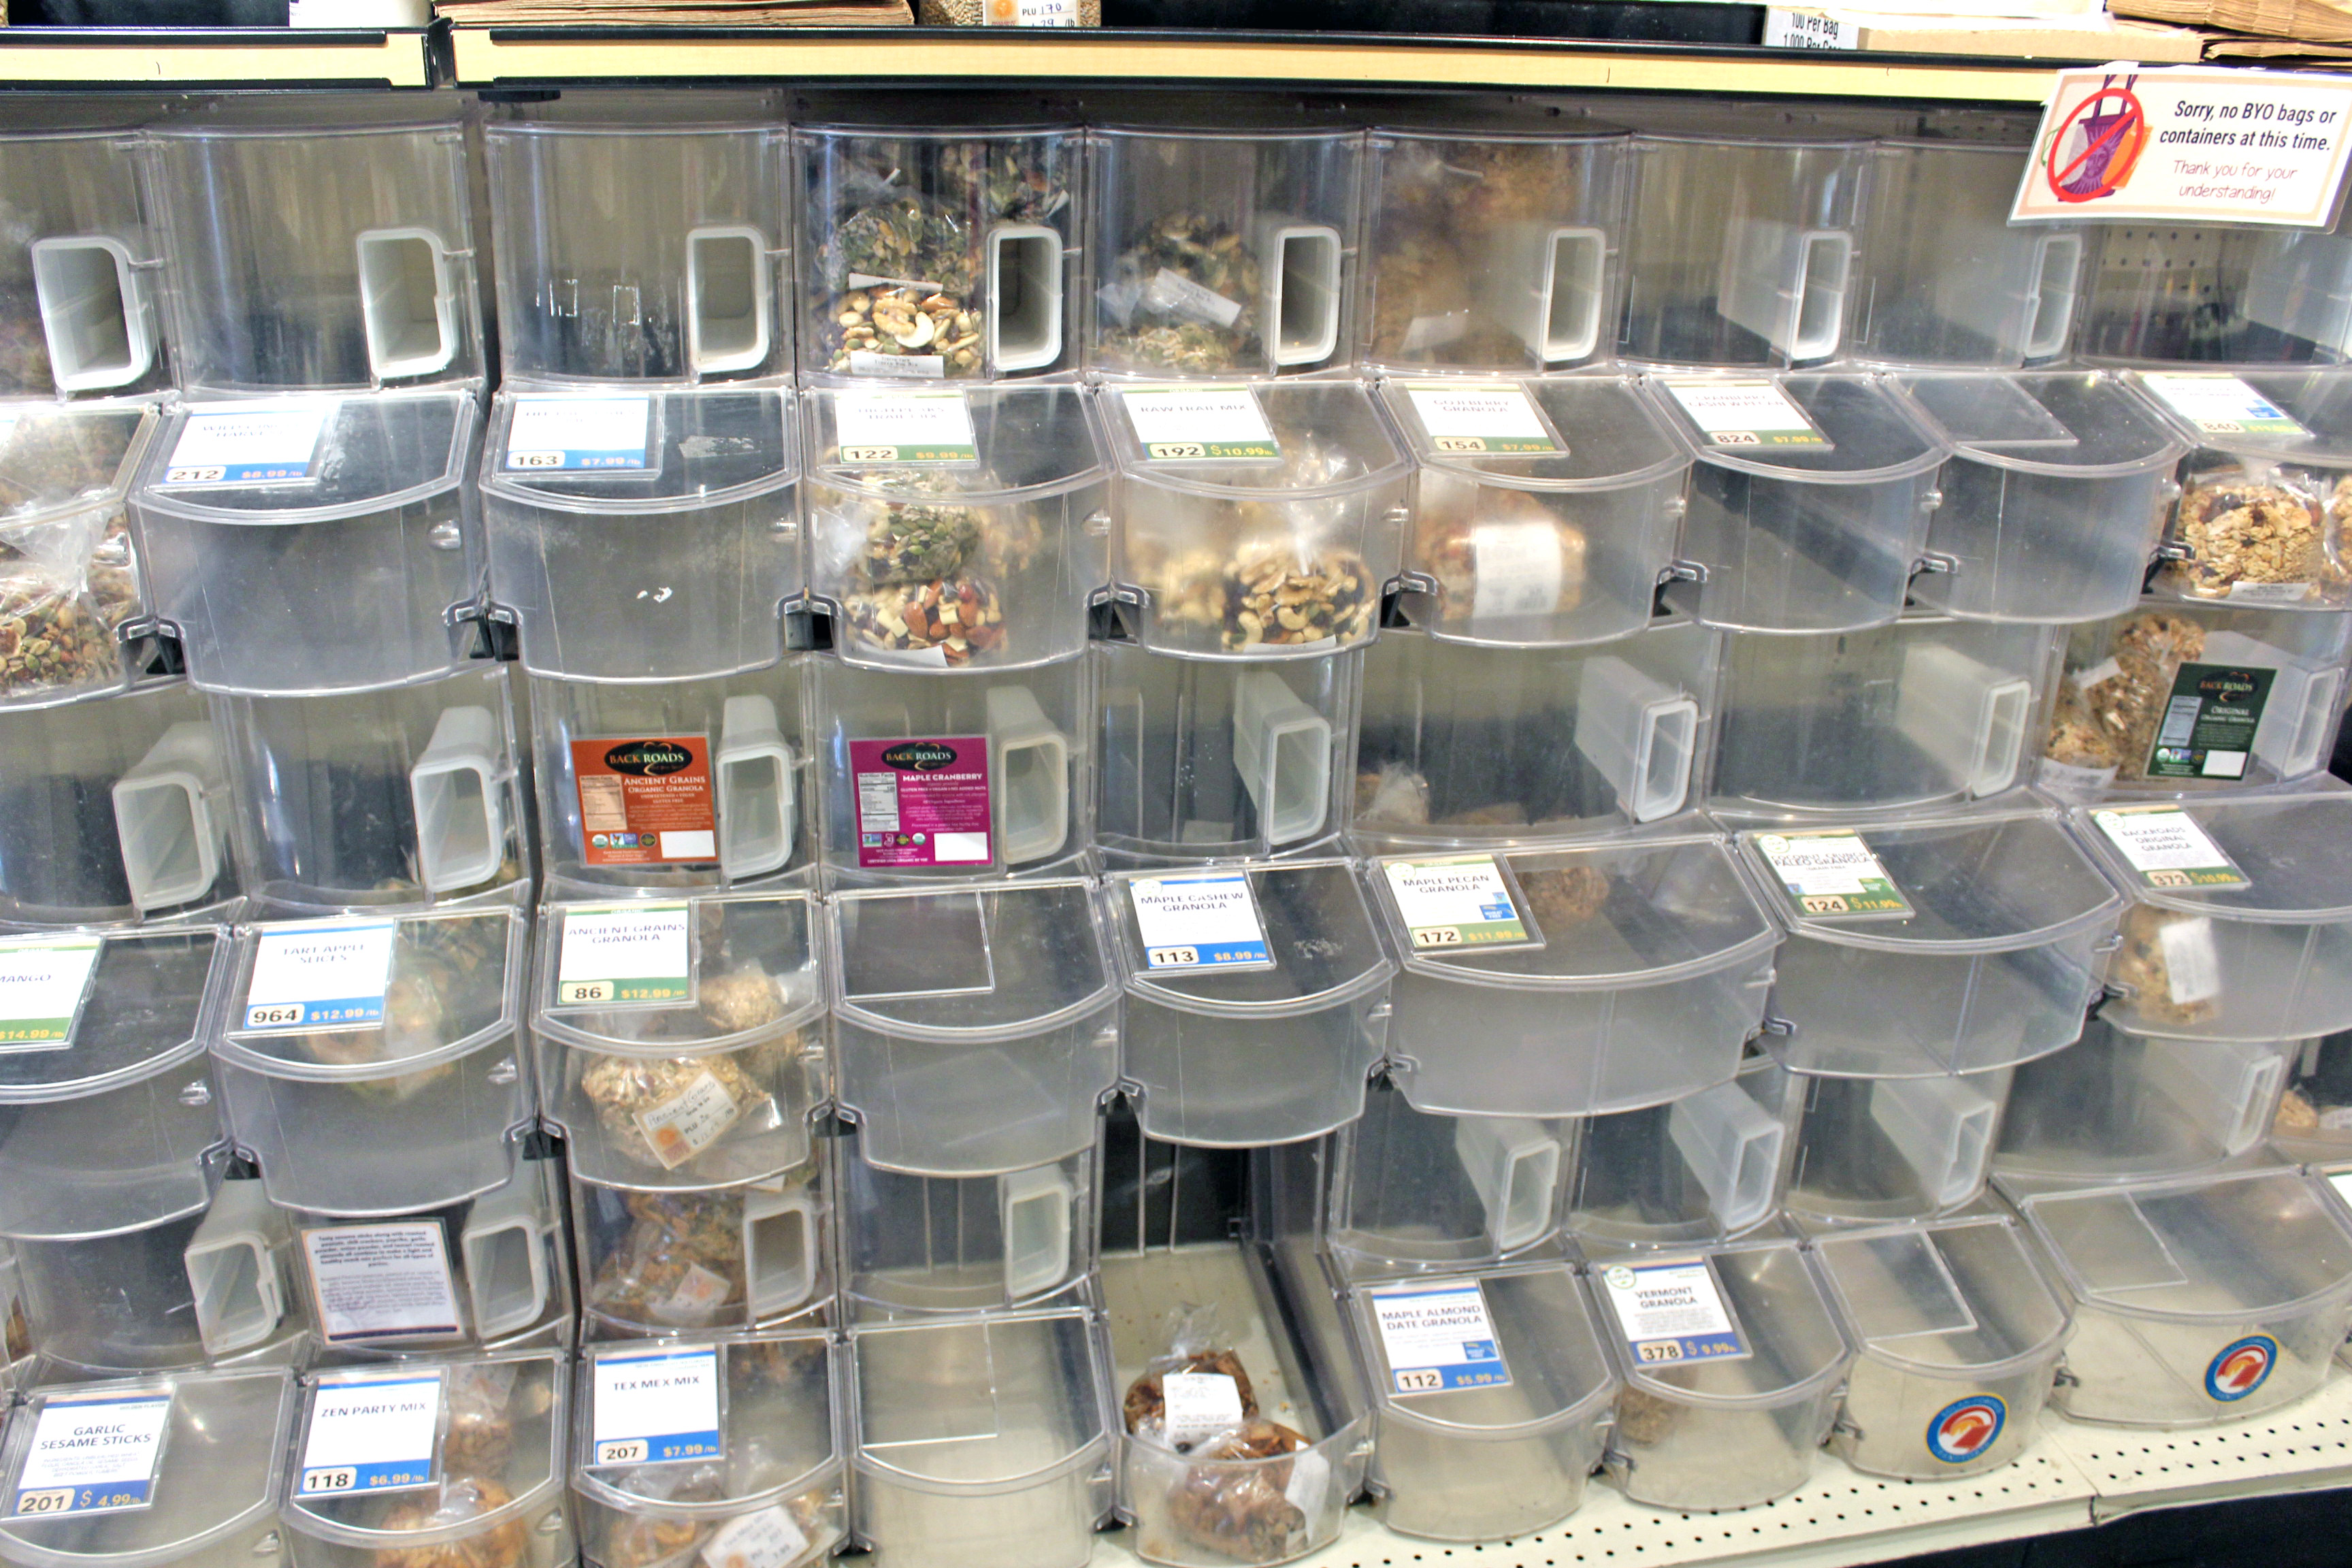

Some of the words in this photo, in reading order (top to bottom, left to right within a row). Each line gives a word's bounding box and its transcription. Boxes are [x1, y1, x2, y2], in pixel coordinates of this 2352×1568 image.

[1022, 7, 1036, 16] PLU
[1041, 3, 1062, 14] 170
[1792, 12, 1806, 29] 100
[1807, 16, 1821, 32] Per
[1823, 18, 1840, 39] Bag
[2174, 100, 2215, 121] Sorry,
[2219, 105, 2238, 118] no
[2242, 103, 2274, 120] BYO
[2277, 104, 2313, 125] bags
[2318, 110, 2337, 124] or
[2159, 129, 2236, 145] containers
[2240, 130, 2257, 146] at
[2259, 131, 2287, 149] this
[2292, 133, 2331, 150] time.
[2174, 160, 2210, 176] Thank
[2212, 164, 2238, 179] you
[2242, 162, 2263, 178] for
[2266, 167, 2298, 180] your
[2178, 184, 2275, 203] understanding!
[1441, 441, 1481, 449] 154
[1717, 435, 1756, 443] 824
[850, 450, 893, 459] 122
[1158, 446, 1201, 457] 192
[515, 456, 558, 466] 163
[581, 457, 625, 466] $7.99
[171, 470, 218, 480] 212
[2200, 681, 2221, 689] BACK
[2223, 682, 2253, 691] ROADS
[609, 754, 641, 764] BACK
[643, 752, 685, 763] ROADS
[885, 753, 914, 762] BACK
[915, 752, 952, 761] ROADS
[624, 777, 666, 785] ANCIENT
[669, 776, 706, 784] GRAINS
[932, 773, 983, 781] CRANBERRY
[2135, 835, 2186, 844] ORIGINAL
[2140, 842, 2193, 852] GRANOLA
[1774, 859, 1812, 867] PALEO
[1814, 858, 1872, 866] GRANOLA
[1403, 878, 1446, 886] MAPLE
[1448, 875, 1490, 884] PECAN
[2154, 875, 2186, 885] 372
[1419, 883, 1481, 894] GRANOLA
[1141, 895, 1186, 904] MAPLE
[1188, 892, 1244, 902] CASHEW
[1162, 902, 1228, 913] GRANOLA
[1807, 900, 1843, 911] 124
[568, 926, 629, 936] ANCIENT
[633, 924, 685, 932] GRAINS
[591, 934, 661, 944] GRANOLA
[1420, 931, 1458, 943] 172
[283, 945, 318, 956] TART
[323, 944, 366, 953] APPLE
[300, 954, 348, 964] SLICES
[1155, 951, 1194, 964] 113
[574, 987, 602, 1000] 86
[621, 988, 671, 999] $12.99
[253, 1009, 297, 1024] 964
[310, 1007, 365, 1022] $12.99
[1635, 1286, 1693, 1299] VERMONT
[1639, 1296, 1698, 1309] GRANOLA
[1382, 1309, 1422, 1321] MAPLE
[1426, 1305, 1481, 1317] ALMOND
[1386, 1322, 1419, 1331] DATE
[1422, 1315, 1482, 1328] GRANOLA
[1644, 1345, 1679, 1360] 378
[613, 1381, 637, 1391] TEX
[641, 1378, 670, 1388] MEX
[674, 1375, 700, 1386] MIX
[1402, 1375, 1439, 1388] 112
[321, 1407, 348, 1418] ZEN
[352, 1405, 396, 1415] PARTY
[400, 1402, 427, 1411] MIX
[74, 1424, 126, 1436] GARLIC
[40, 1437, 99, 1450] SESAME
[102, 1433, 151, 1446] STICKS
[606, 1446, 638, 1460] 207
[663, 1443, 703, 1458] $7.99
[309, 1473, 349, 1489] 118
[369, 1473, 410, 1486] $6.99
[21, 1495, 65, 1512] 201
[80, 1490, 93, 1507] $
